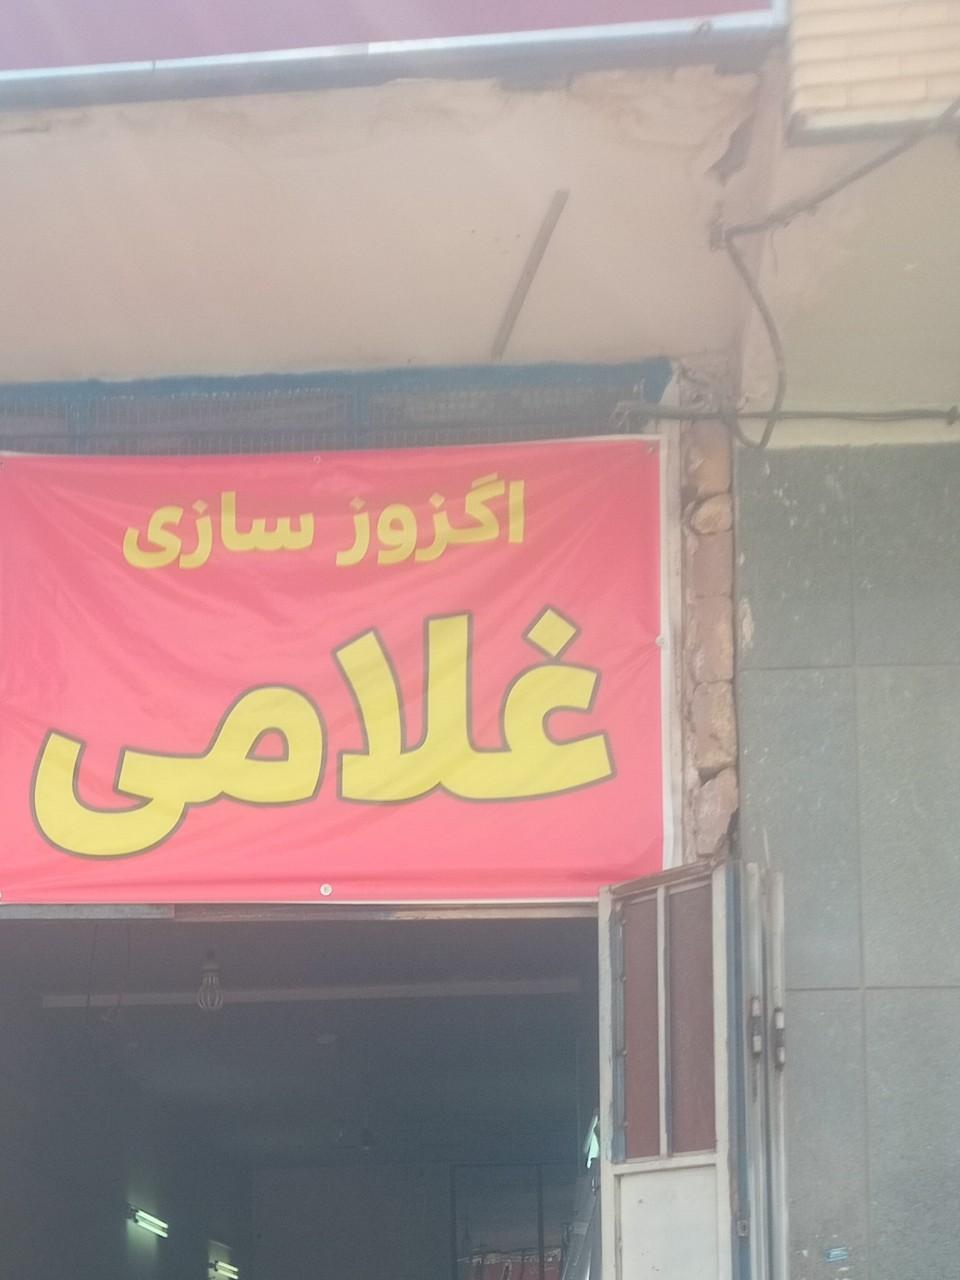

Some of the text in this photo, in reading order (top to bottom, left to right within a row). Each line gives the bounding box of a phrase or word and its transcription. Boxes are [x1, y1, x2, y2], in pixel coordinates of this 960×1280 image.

[123, 473, 525, 569] اگزوز سازی
[30, 608, 615, 859] غلامی
